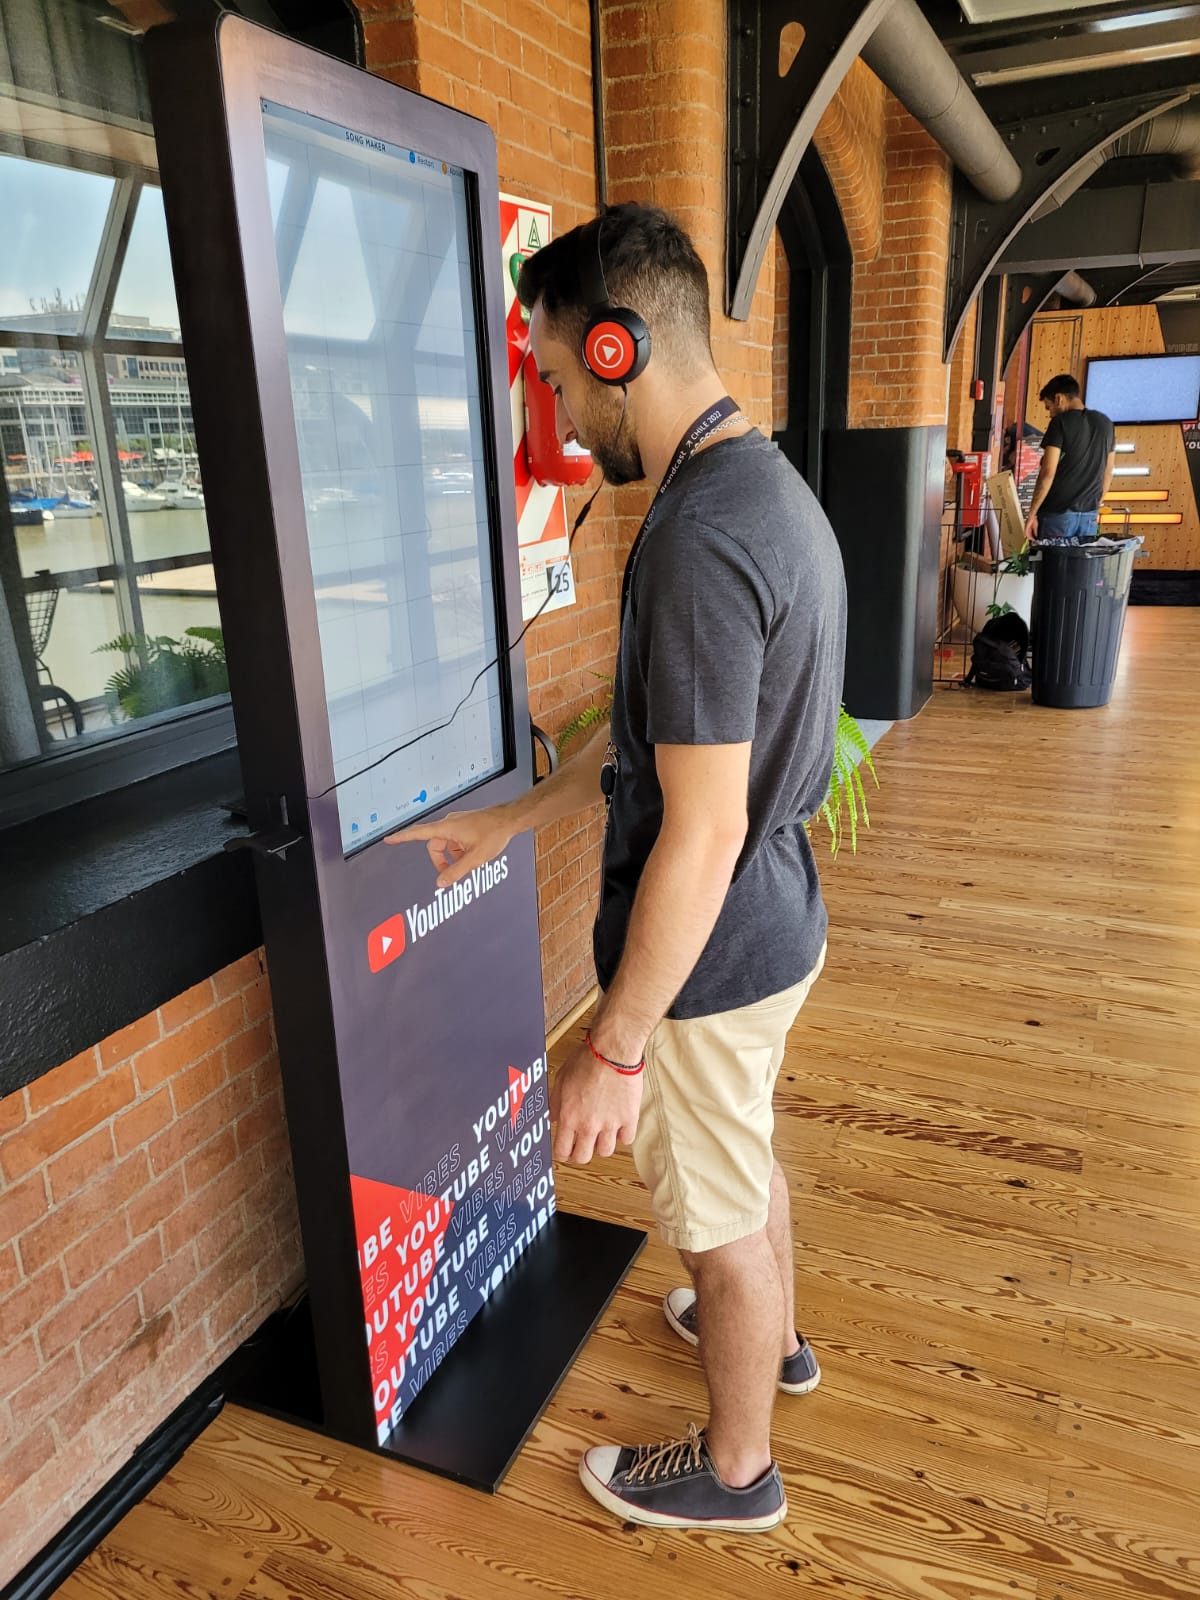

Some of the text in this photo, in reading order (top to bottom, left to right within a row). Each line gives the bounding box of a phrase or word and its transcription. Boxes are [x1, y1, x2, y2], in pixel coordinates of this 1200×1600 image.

[345, 131, 386, 152] SONG MAKER
[660, 450, 687, 494] Brandcast
[691, 410, 722, 440] CHILE 2022
[555, 572, 570, 594] 25
[359, 1052, 547, 1271] BE VIBES YOUTUB
[395, 1144, 491, 1267] YOUTUBE
[495, 1087, 545, 1152] VIBES
[451, 1163, 506, 1238] VIBES
[395, 1214, 490, 1343] YOUTUBE
[493, 1150, 543, 1220] VIBES
[409, 1310, 470, 1398] VIBES
[479, 1195, 557, 1302] YOUTUBE
[374, 1285, 461, 1412] OUTUBE
[465, 1213, 518, 1290] VIBES
